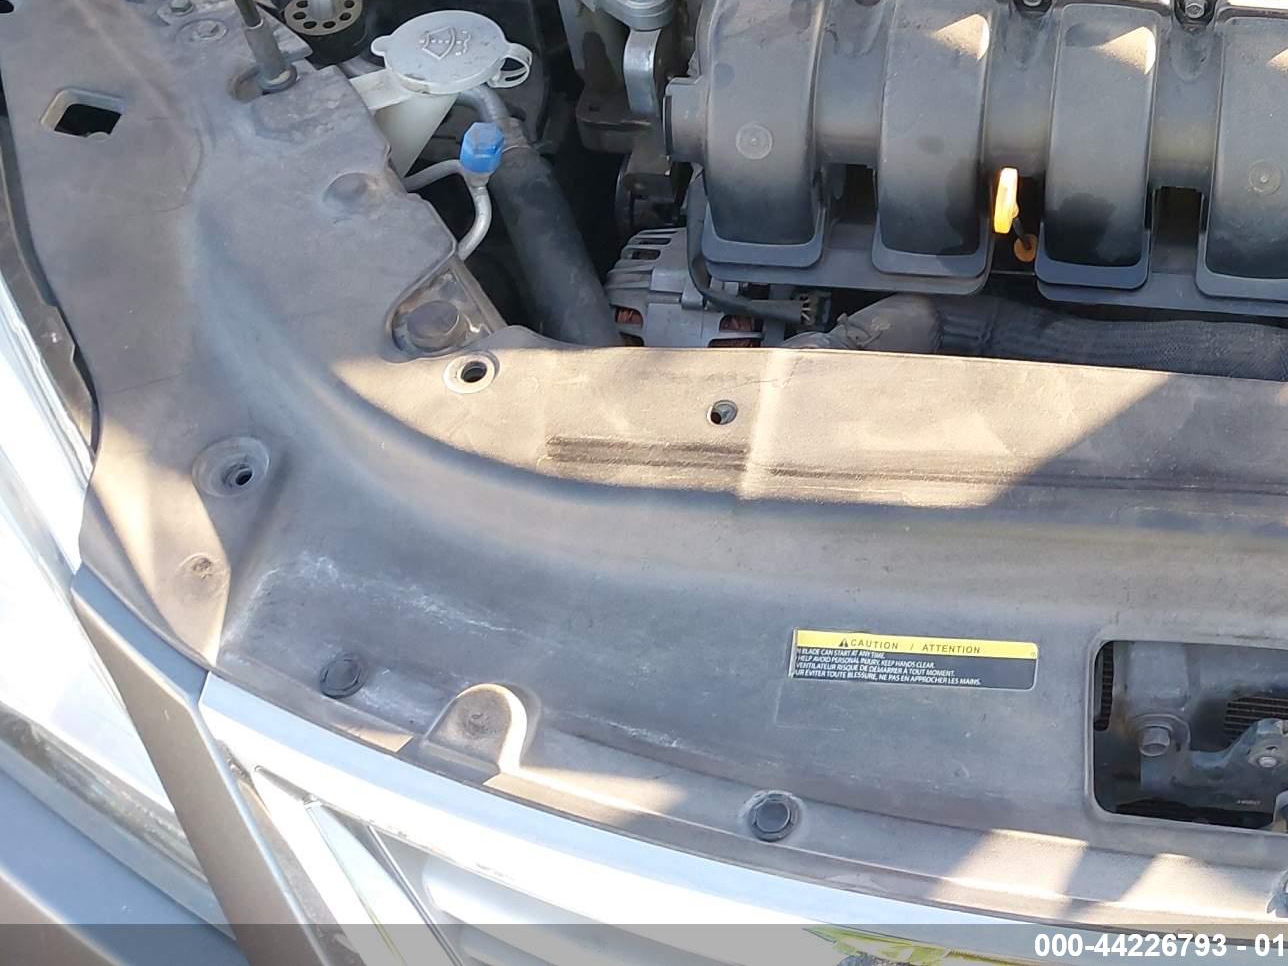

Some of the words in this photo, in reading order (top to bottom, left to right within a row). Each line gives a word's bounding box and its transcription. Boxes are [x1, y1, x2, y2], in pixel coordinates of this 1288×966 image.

[851, 639, 899, 650] CAUTION
[922, 644, 981, 654] ATTENTION
[796, 662, 837, 670] VENTILATEUR
[837, 663, 858, 671] RISQUE
[860, 664, 868, 672] DE
[909, 667, 925, 675] TOUT
[831, 657, 859, 665] PERSONAL
[896, 660, 915, 668] HANDS
[878, 673, 887, 681] NE
[888, 673, 900, 681] PAS
[900, 674, 909, 682] EN
[910, 675, 947, 684] APPROCHER
[948, 677, 959, 685] LES
